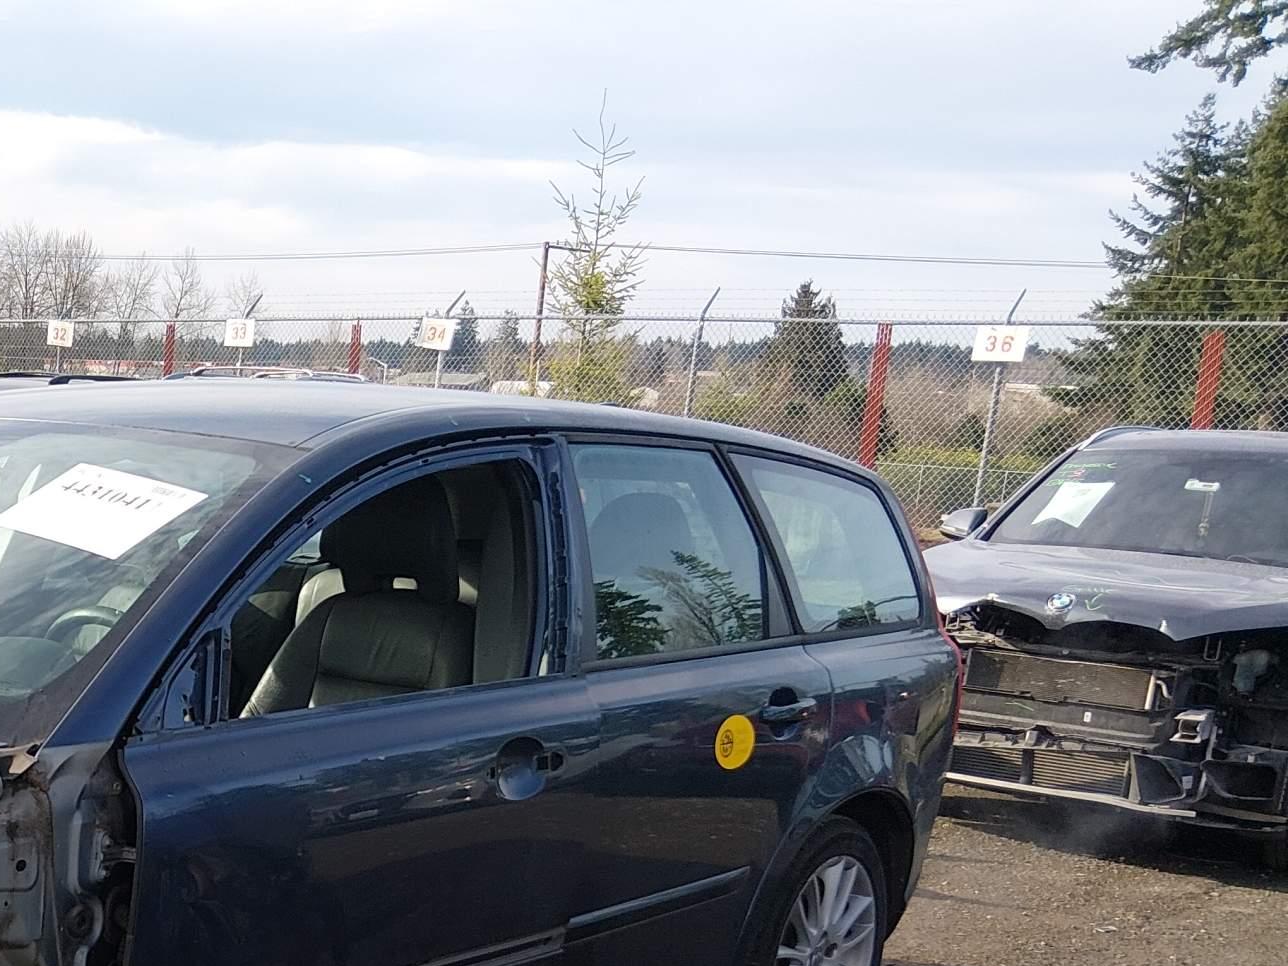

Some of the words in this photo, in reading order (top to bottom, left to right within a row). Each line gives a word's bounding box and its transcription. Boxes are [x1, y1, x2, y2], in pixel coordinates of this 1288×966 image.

[53, 327, 67, 341] 32
[231, 326, 247, 340] 33
[427, 326, 447, 343] 34
[985, 335, 1015, 353] 36
